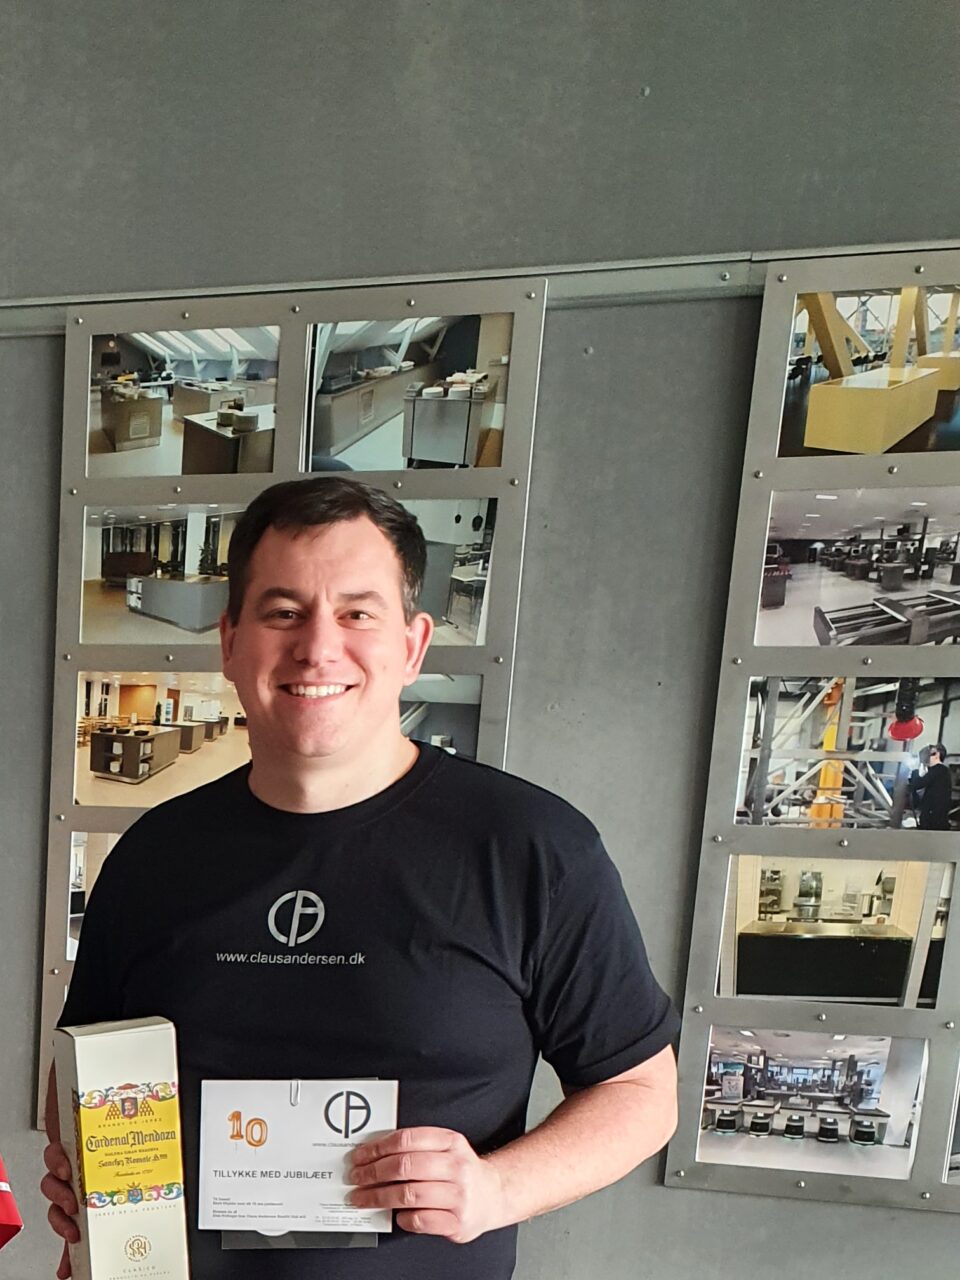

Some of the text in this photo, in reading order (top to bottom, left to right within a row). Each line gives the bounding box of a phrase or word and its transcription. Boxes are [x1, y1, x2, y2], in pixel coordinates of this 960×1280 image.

[216, 952, 365, 965] www.clausandersen.dk
[227, 1110, 268, 1147] 10
[86, 1129, 176, 1152] Cardenal Mendoza
[213, 1170, 333, 1180] TILLYKKE MED JUBILÆET
